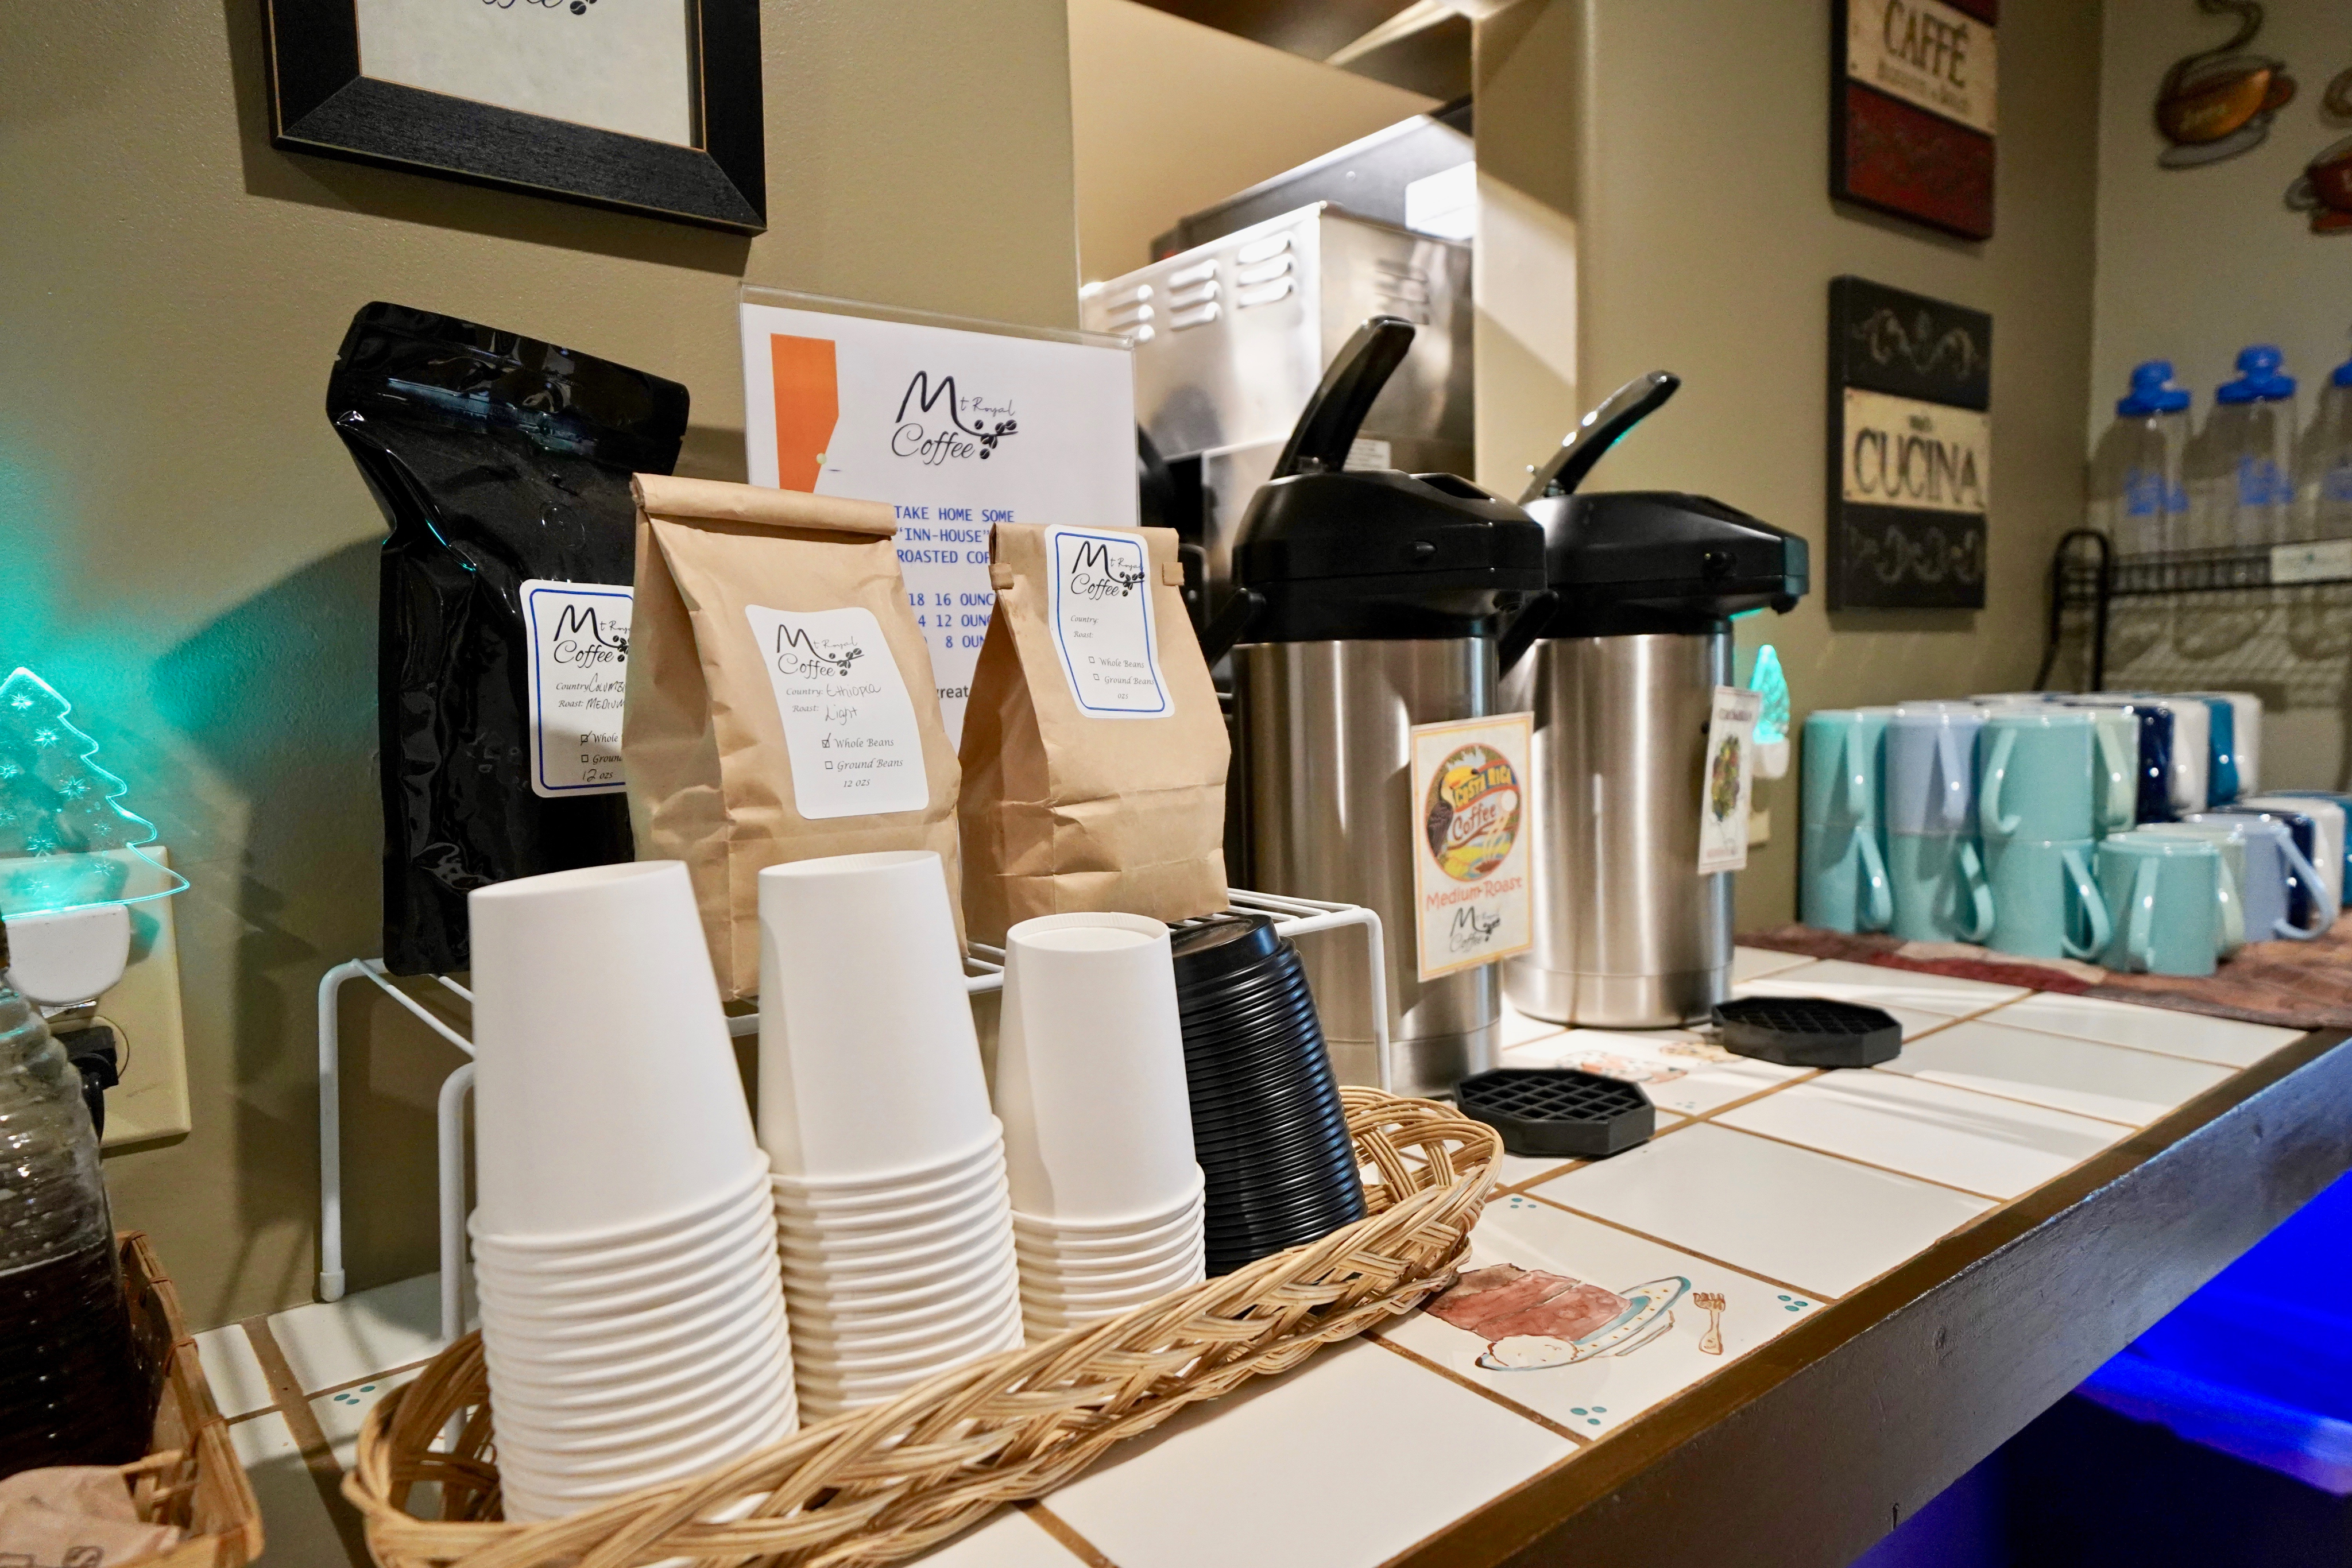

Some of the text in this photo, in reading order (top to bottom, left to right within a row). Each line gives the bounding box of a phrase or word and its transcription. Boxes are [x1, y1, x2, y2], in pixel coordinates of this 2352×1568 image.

[973, 397, 1016, 417] Royal
[892, 423, 975, 465] Coffee
[1854, 428, 1986, 508] CUCINA
[894, 506, 1015, 522] TAKE HOME SOME
[897, 549, 958, 563] ROASTED
[1071, 573, 1120, 601] Coffee
[908, 593, 997, 606] 18 16 OUNC
[936, 614, 952, 627] 12
[1070, 614, 1098, 625] Country:
[821, 636, 858, 649] Royal
[946, 636, 953, 648] 8
[554, 640, 614, 668] Coffee
[778, 653, 835, 679] Coffee
[1099, 657, 1144, 668] Whole Beans
[1104, 676, 1155, 685] Ground Beans
[786, 684, 881, 697] Country: Ethiopia
[825, 704, 857, 725] Light
[591, 733, 618, 743] Whole
[834, 738, 894, 748] Whole Beans
[837, 759, 903, 772] Ground Beans
[582, 769, 597, 782] 12
[843, 779, 870, 788] 12 ozs
[1453, 803, 1496, 841] Coffee
